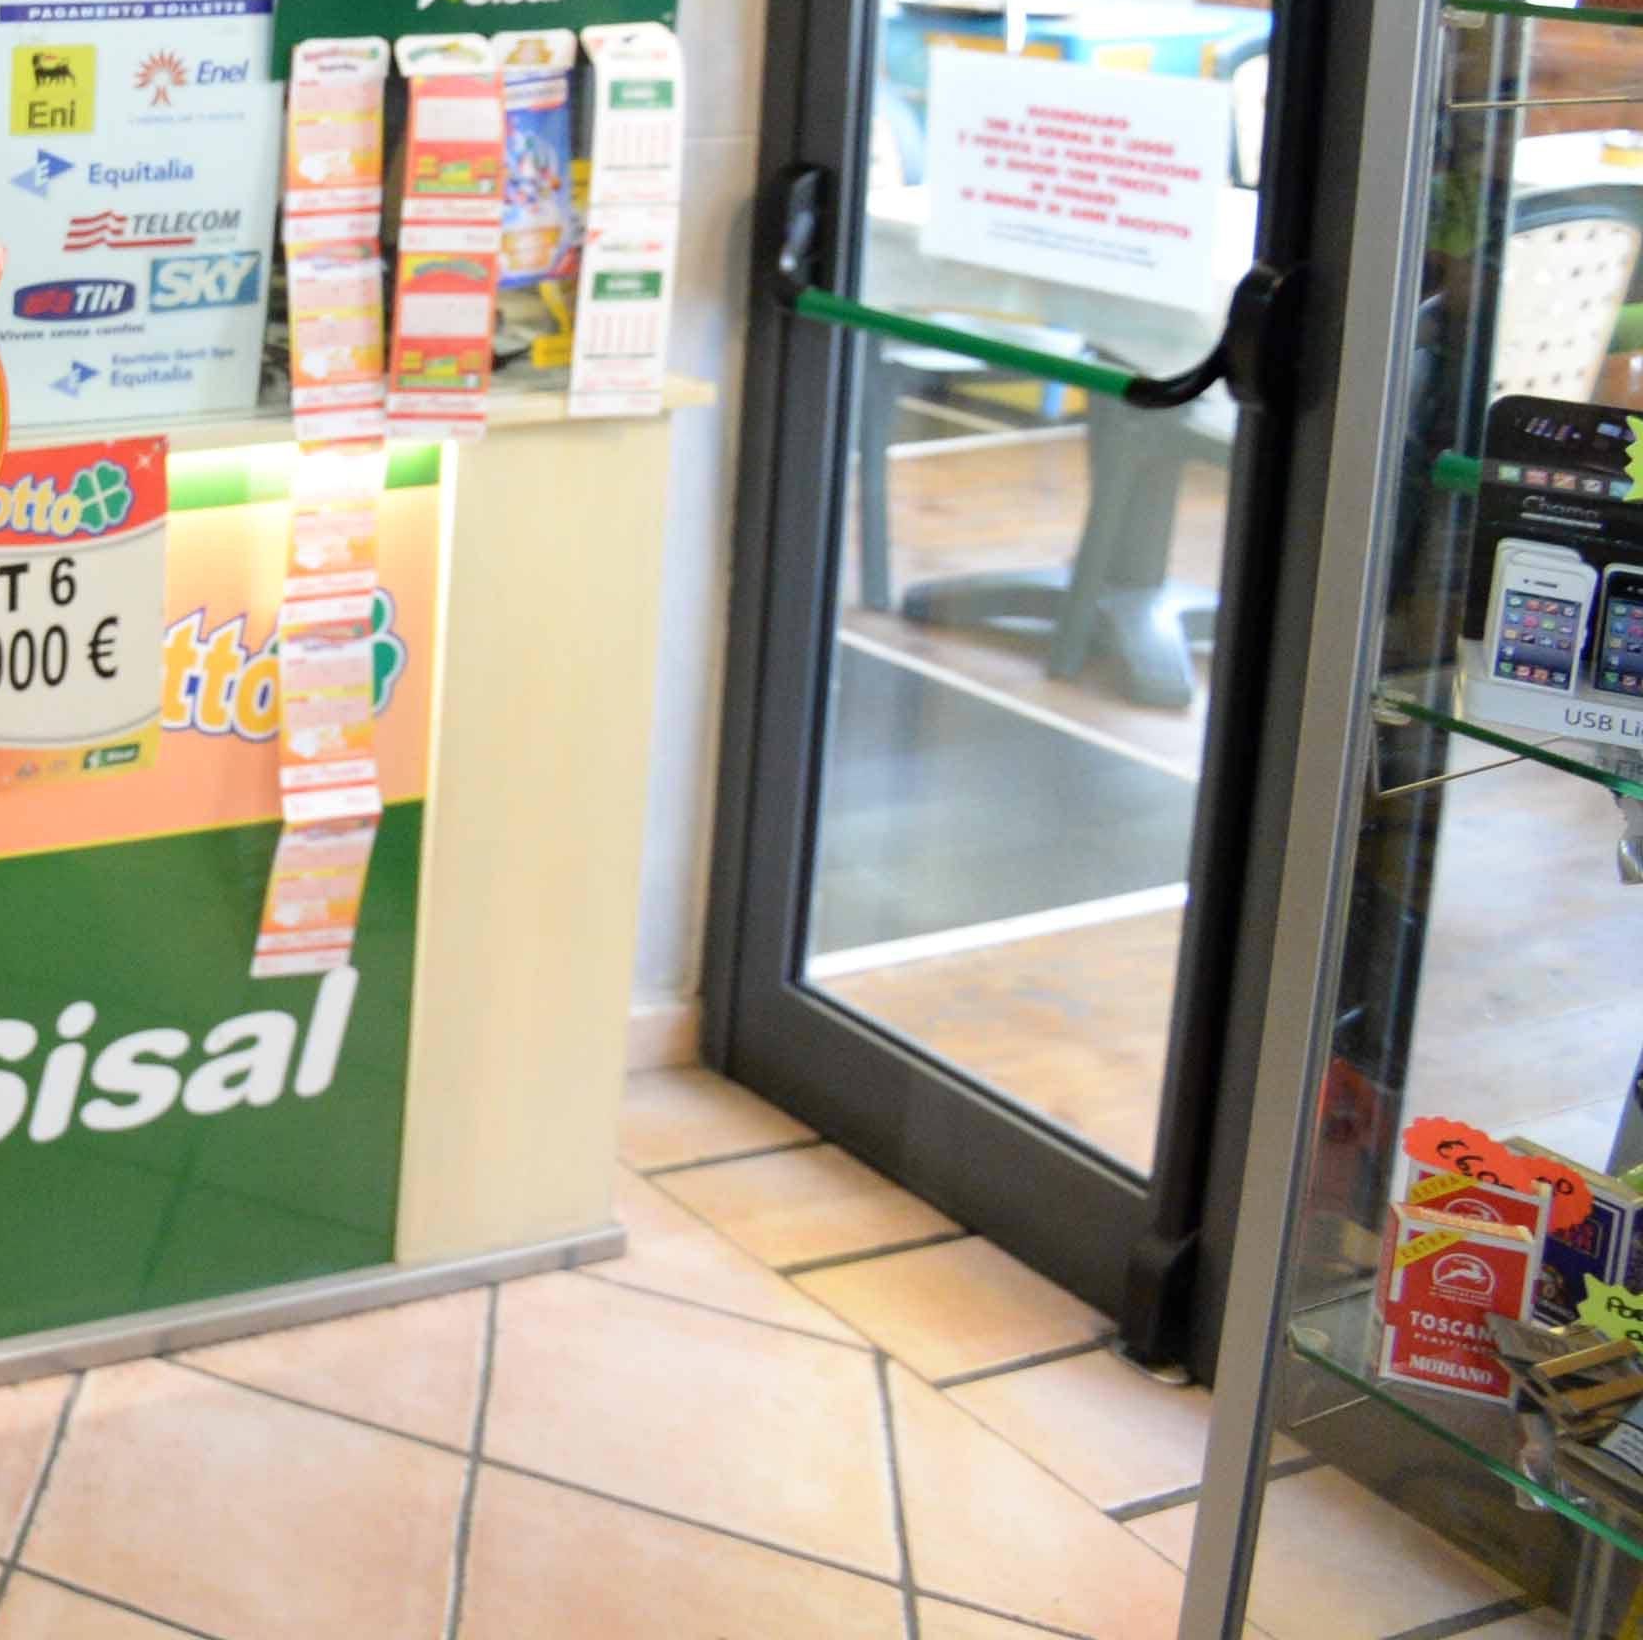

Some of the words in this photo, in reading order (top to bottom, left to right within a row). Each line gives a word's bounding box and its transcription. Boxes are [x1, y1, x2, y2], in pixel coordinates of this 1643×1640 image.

[27, 3, 146, 21] PAGAMENTO
[152, 0, 247, 18] BOLLETTE
[196, 58, 250, 86] Enel
[27, 98, 78, 131] Eni
[87, 161, 195, 190] Equitalia
[130, 209, 242, 235] TELECOM
[74, 281, 129, 313] TIM
[153, 253, 261, 310] SKY
[49, 556, 77, 607] 6
[87, 615, 119, 679] €
[1564, 706, 1613, 733] USB
[1619, 717, 1643, 740] Li
[1409, 1310, 1501, 1343] TOSCAN
[1409, 1353, 1494, 1385] MODIANO
